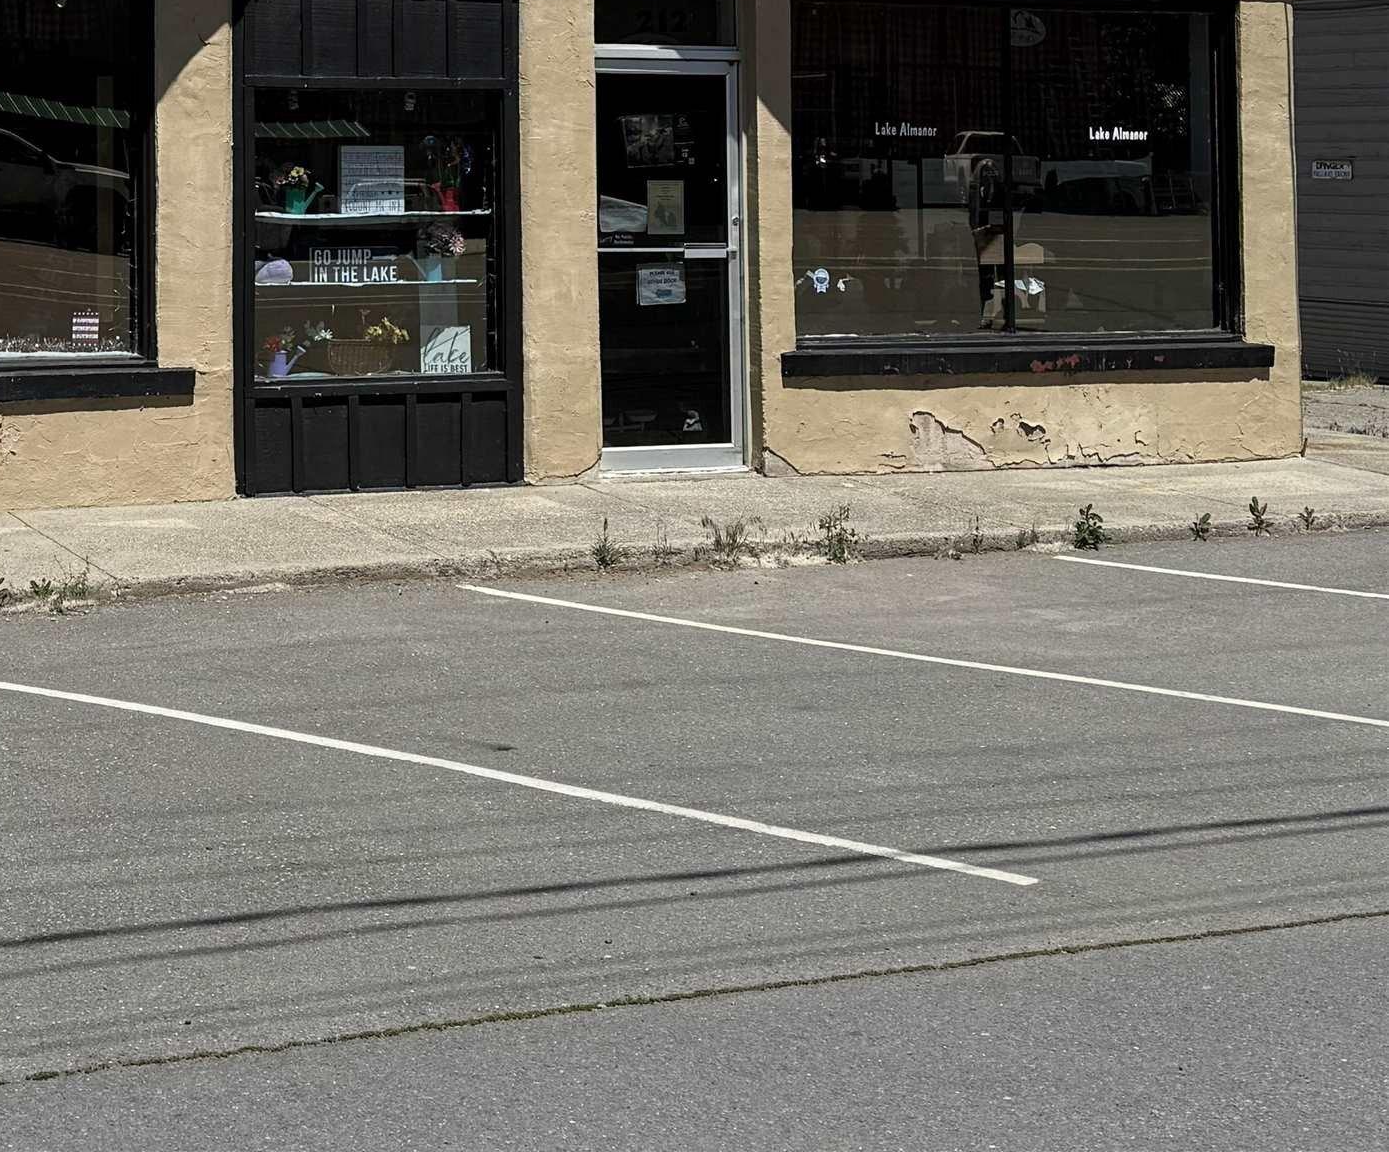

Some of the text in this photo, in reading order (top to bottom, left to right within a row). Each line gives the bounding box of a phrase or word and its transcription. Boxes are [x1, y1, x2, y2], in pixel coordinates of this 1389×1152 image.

[875, 121, 938, 137] Lake Almanor
[1089, 126, 1149, 141] Lake Almanor
[314, 249, 371, 265] GO JUMP
[314, 266, 398, 283] IN THE LAKE
[450, 364, 468, 373] BEST
